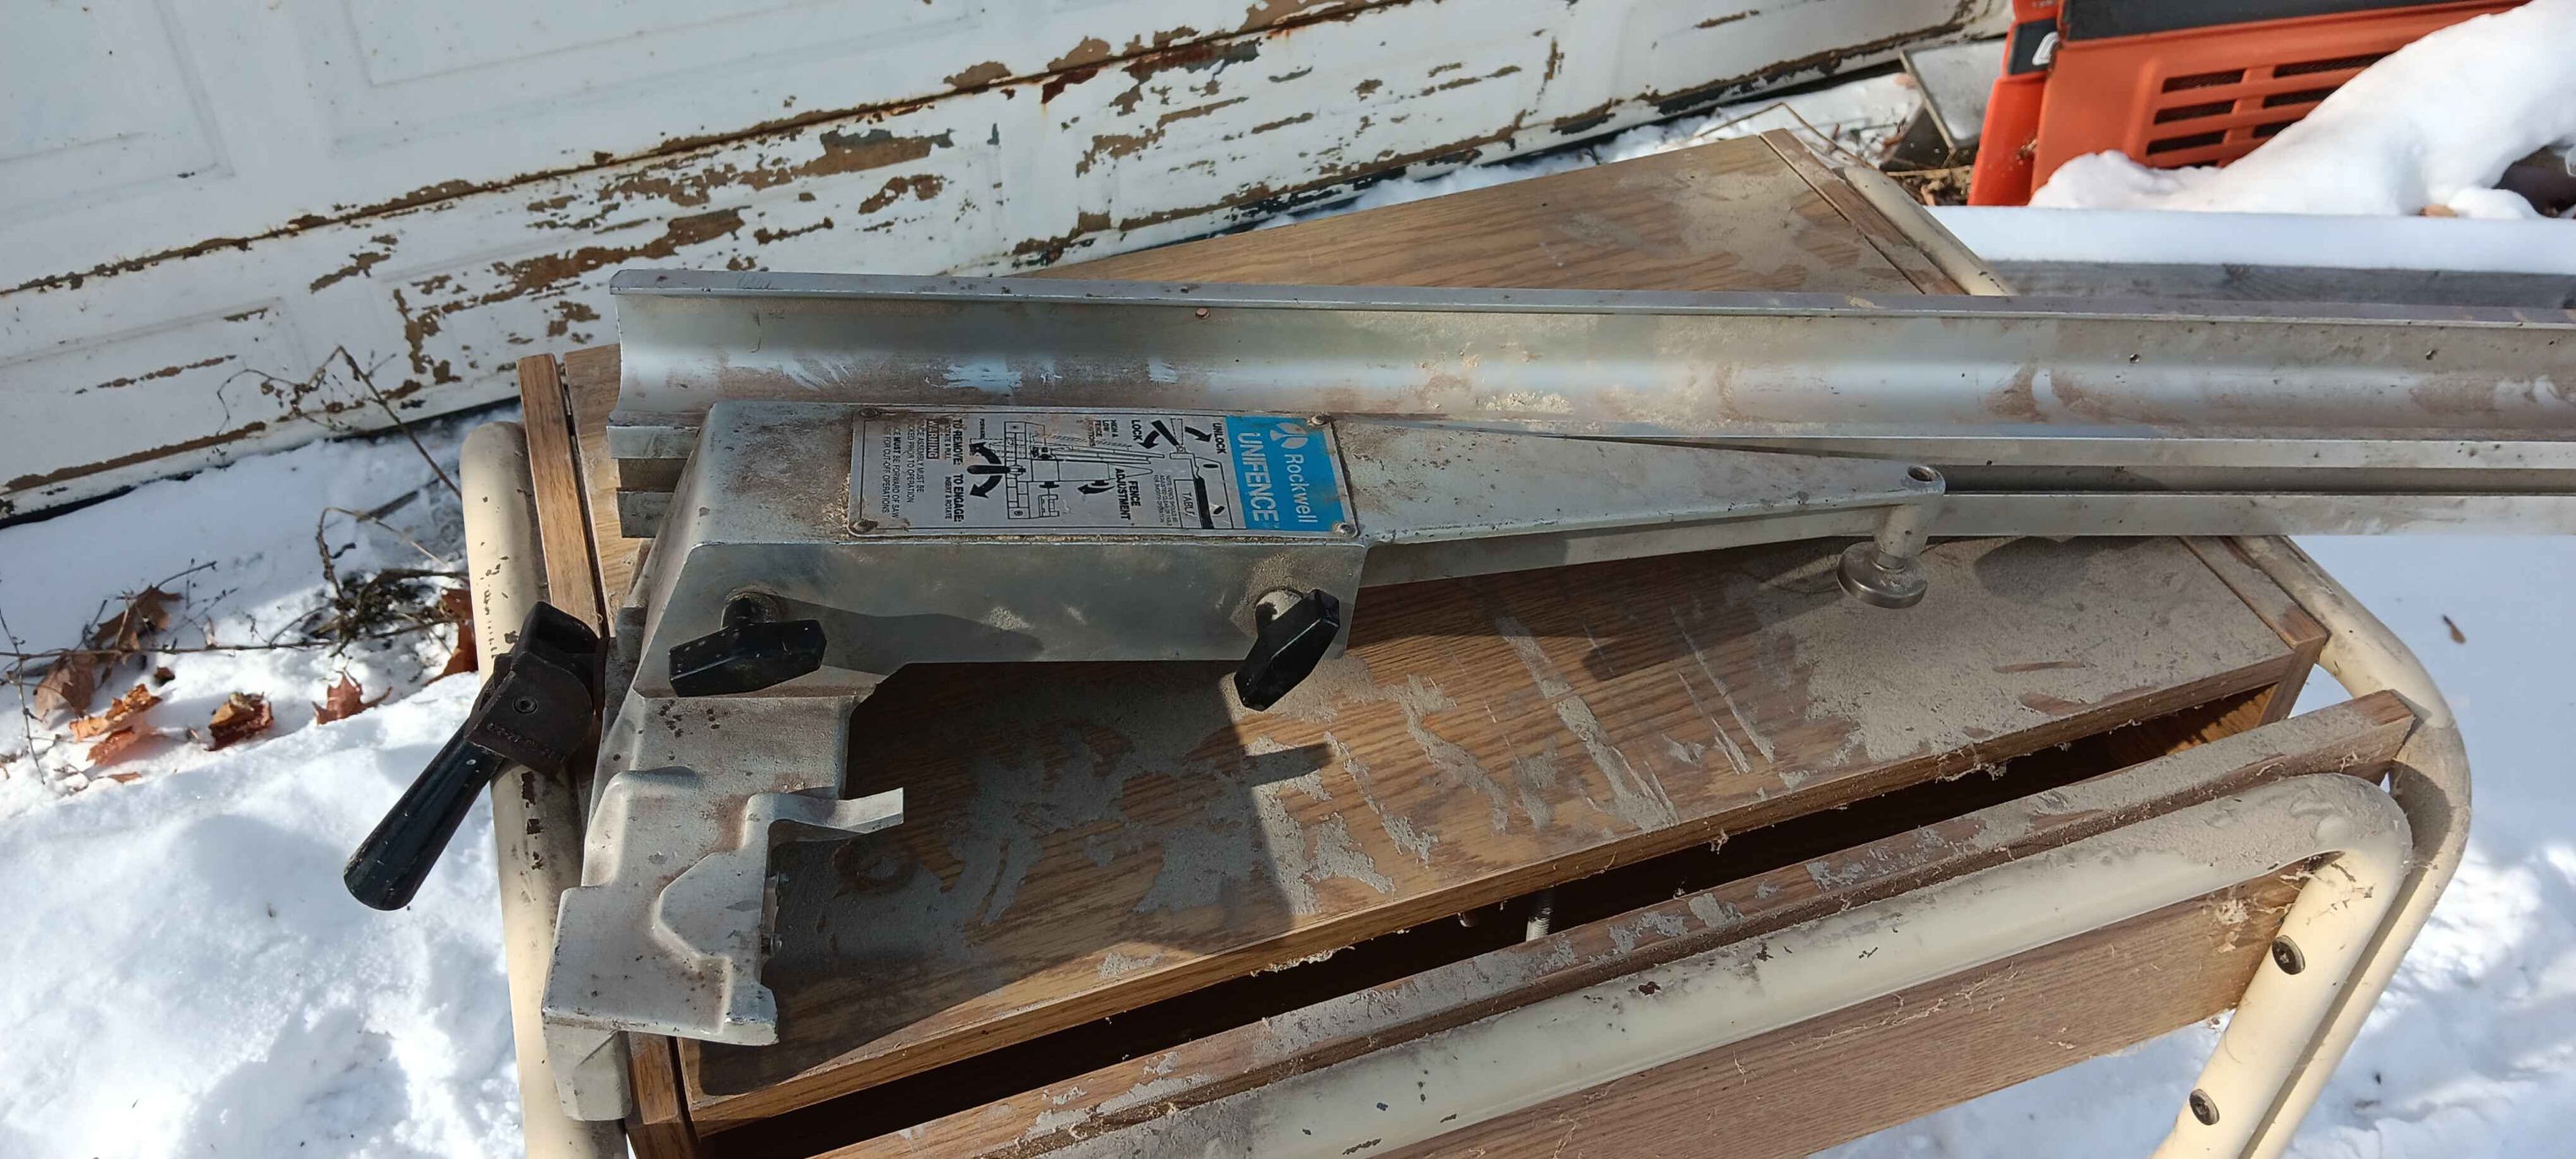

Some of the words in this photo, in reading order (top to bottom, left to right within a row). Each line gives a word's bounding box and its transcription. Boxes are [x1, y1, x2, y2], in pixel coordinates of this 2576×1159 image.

[928, 420, 938, 458] WARNING
[1131, 420, 1142, 441] LOCK
[1212, 423, 1226, 454] UNLOCK
[893, 455, 900, 463] BE
[953, 430, 963, 465] REMOVE:
[907, 460, 914, 468] TO
[1238, 432, 1279, 521] UNIFENCE
[892, 465, 900, 493] FORWARD
[917, 485, 924, 493] BE
[953, 474, 963, 485] TO
[1128, 481, 1141, 506] FENCE
[1284, 454, 1318, 523] Rockwell
[953, 486, 964, 522] ENGAGE:
[1115, 468, 1131, 520] ADJUSTMENT
